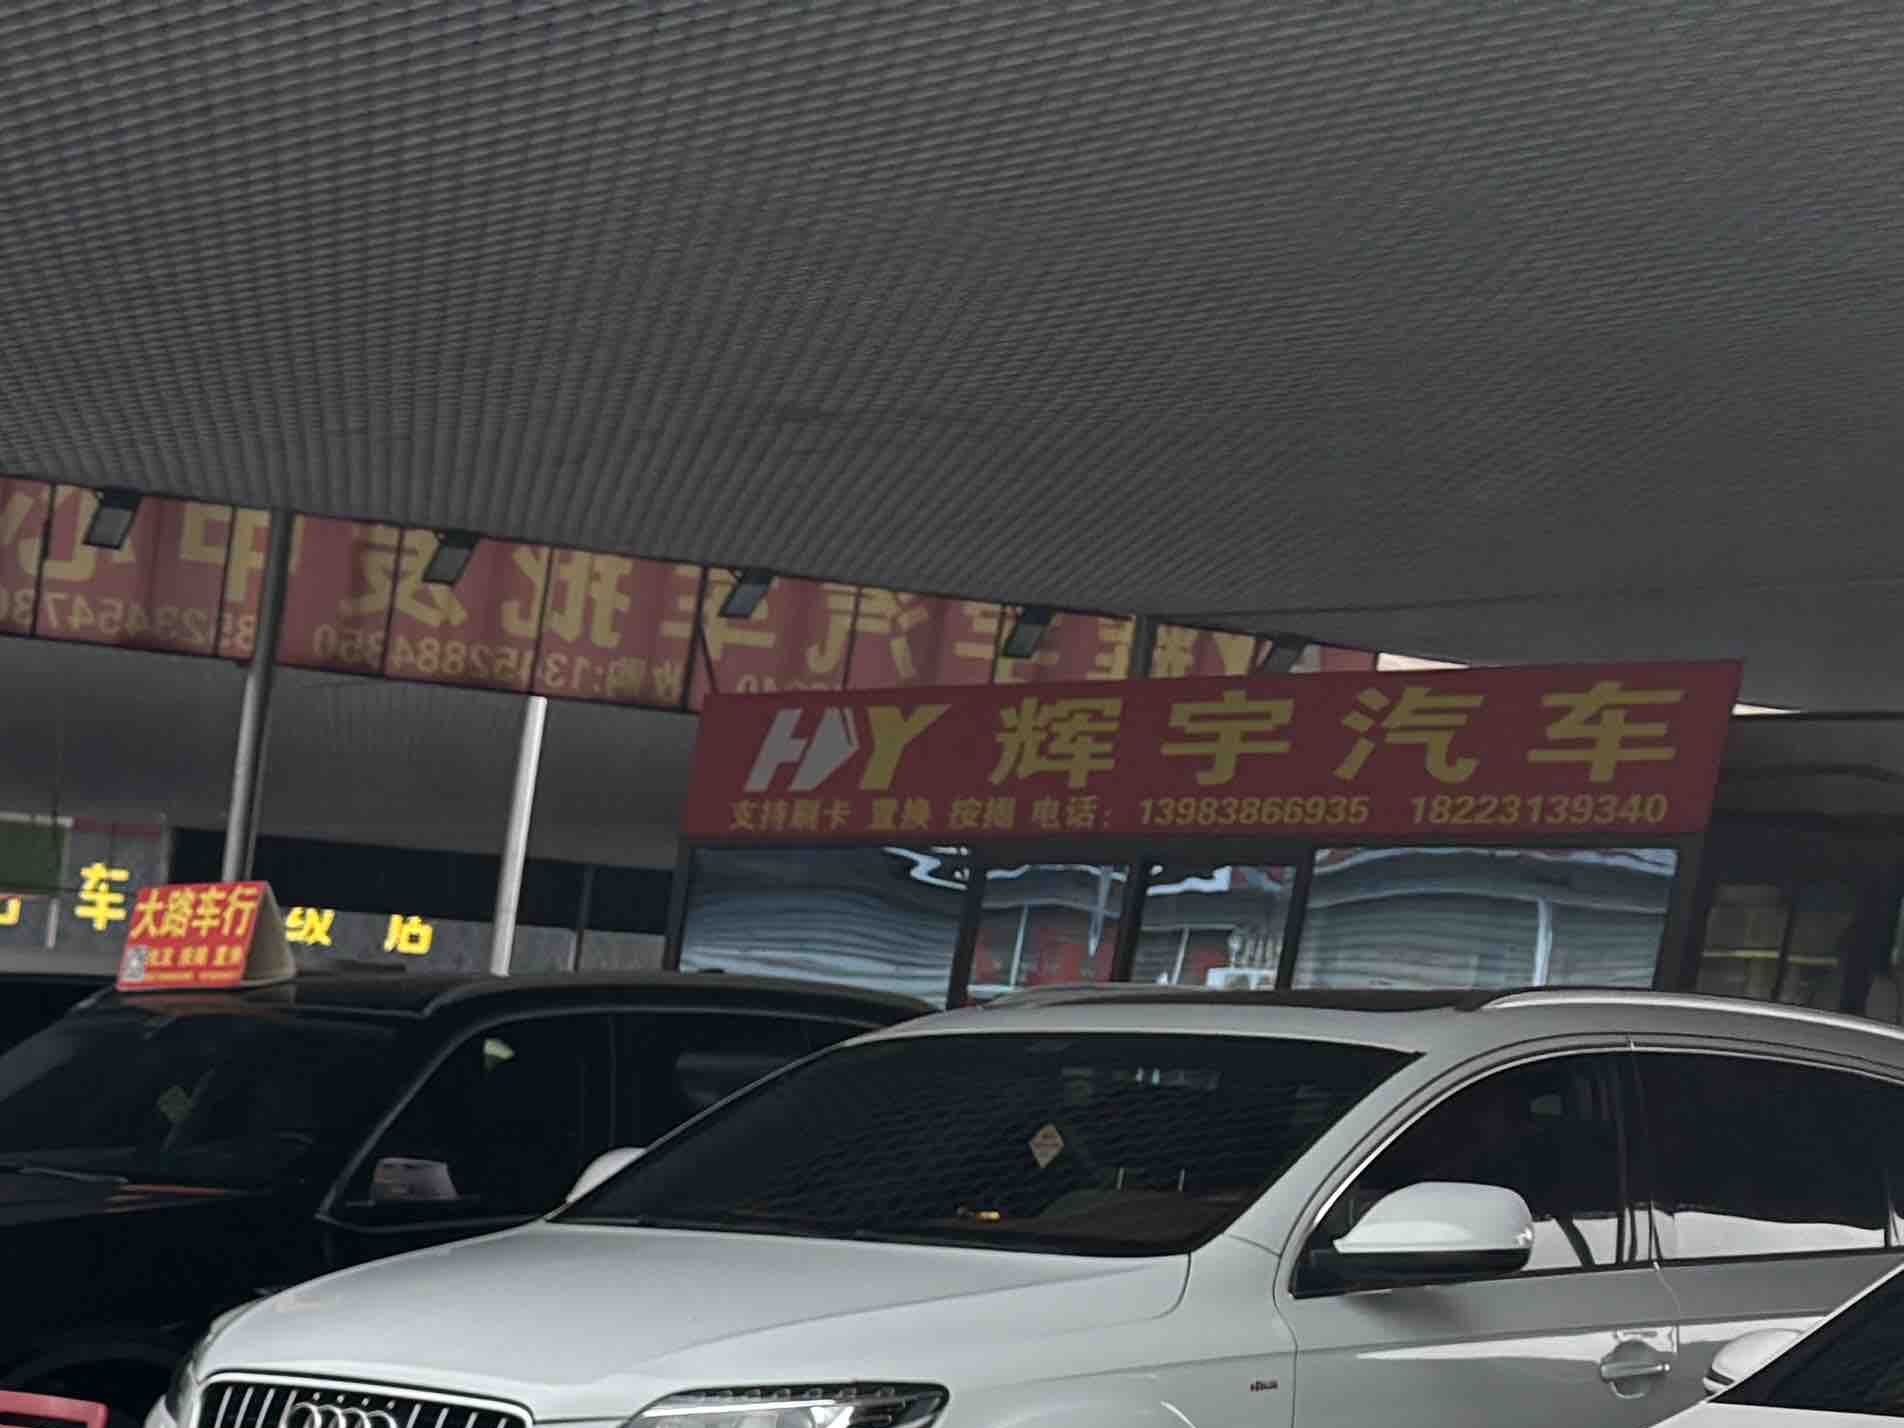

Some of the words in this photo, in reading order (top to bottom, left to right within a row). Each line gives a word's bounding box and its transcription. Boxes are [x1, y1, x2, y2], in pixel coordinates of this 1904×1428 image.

[989, 680, 1686, 790] 辉宇汽车
[1410, 792, 1669, 826] 18223139340
